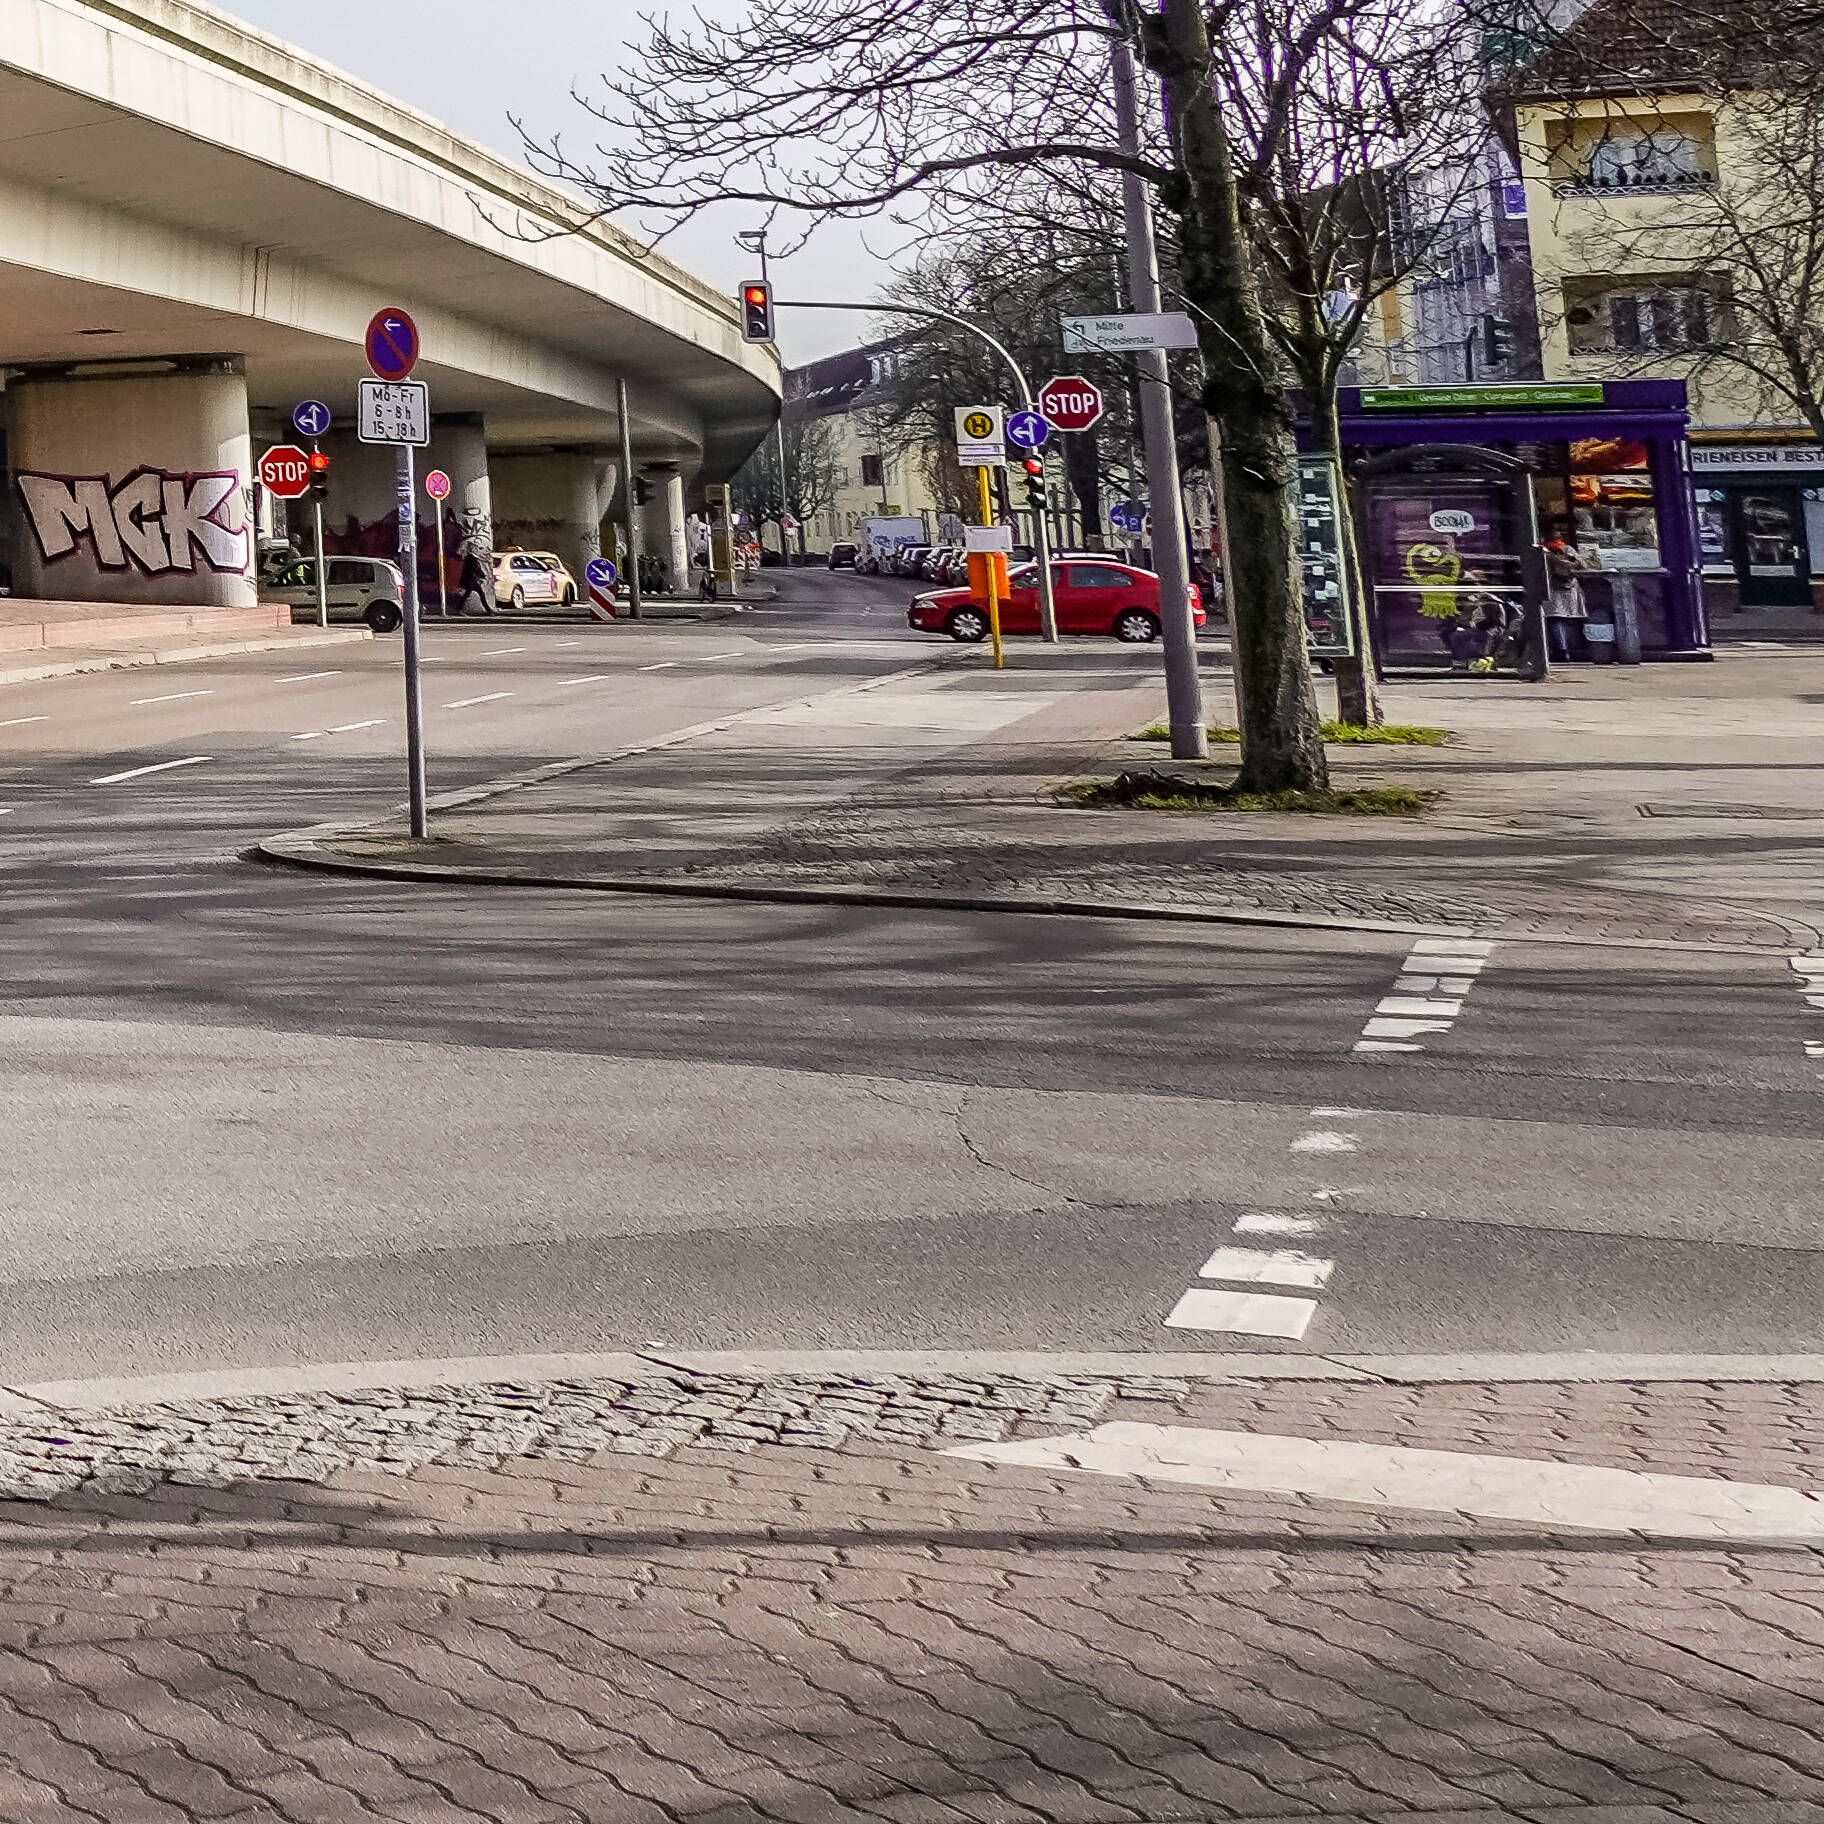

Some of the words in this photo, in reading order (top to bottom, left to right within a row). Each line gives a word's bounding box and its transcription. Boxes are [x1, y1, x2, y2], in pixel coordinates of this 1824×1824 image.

[1095, 321, 1124, 331] Mitte
[1045, 393, 1094, 415] STOP
[264, 461, 308, 482] STOP
